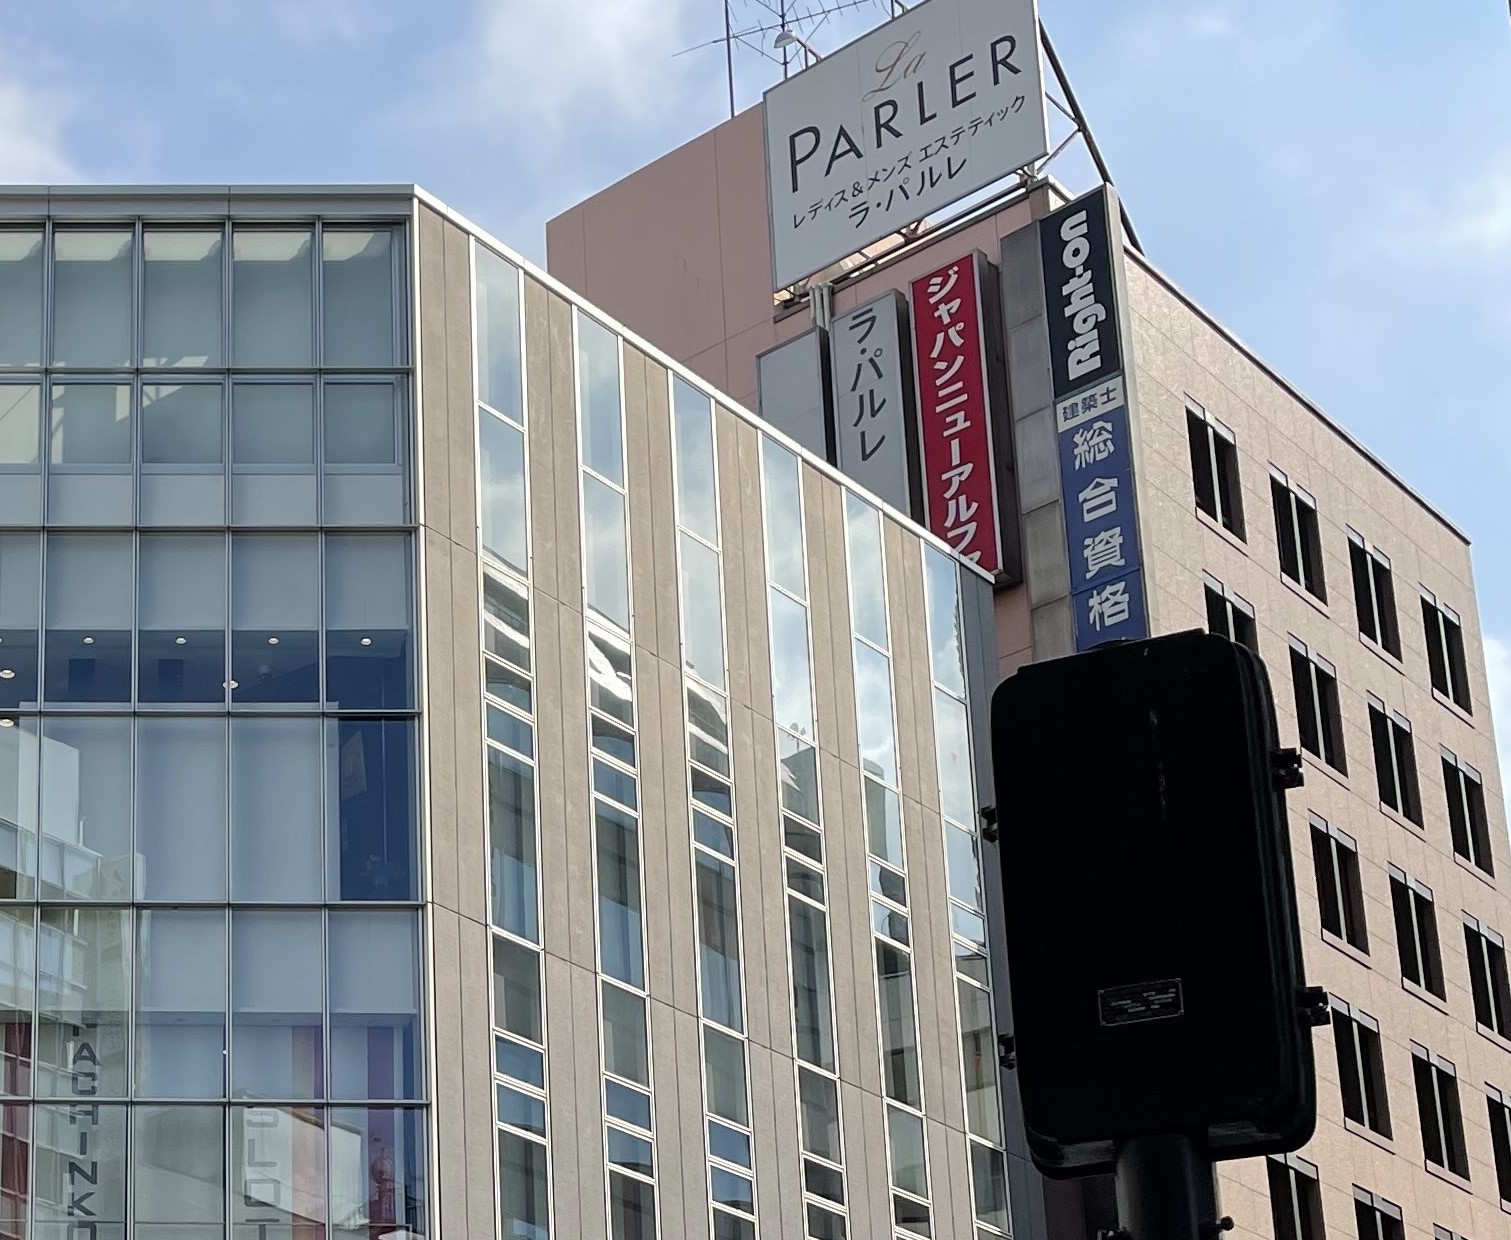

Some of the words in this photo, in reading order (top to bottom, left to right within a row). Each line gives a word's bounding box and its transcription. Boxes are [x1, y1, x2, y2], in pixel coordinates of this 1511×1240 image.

[789, 35, 1022, 193] PARLER
[863, 30, 927, 101] La
[919, 95, 1025, 162] エステティック
[848, 156, 967, 228] ラ・パルレ
[1062, 209, 1106, 381] Right-on
[848, 308, 888, 462] ラ・パルレ
[1062, 386, 1117, 422] 建築士
[1072, 421, 1131, 632] 総合資格
